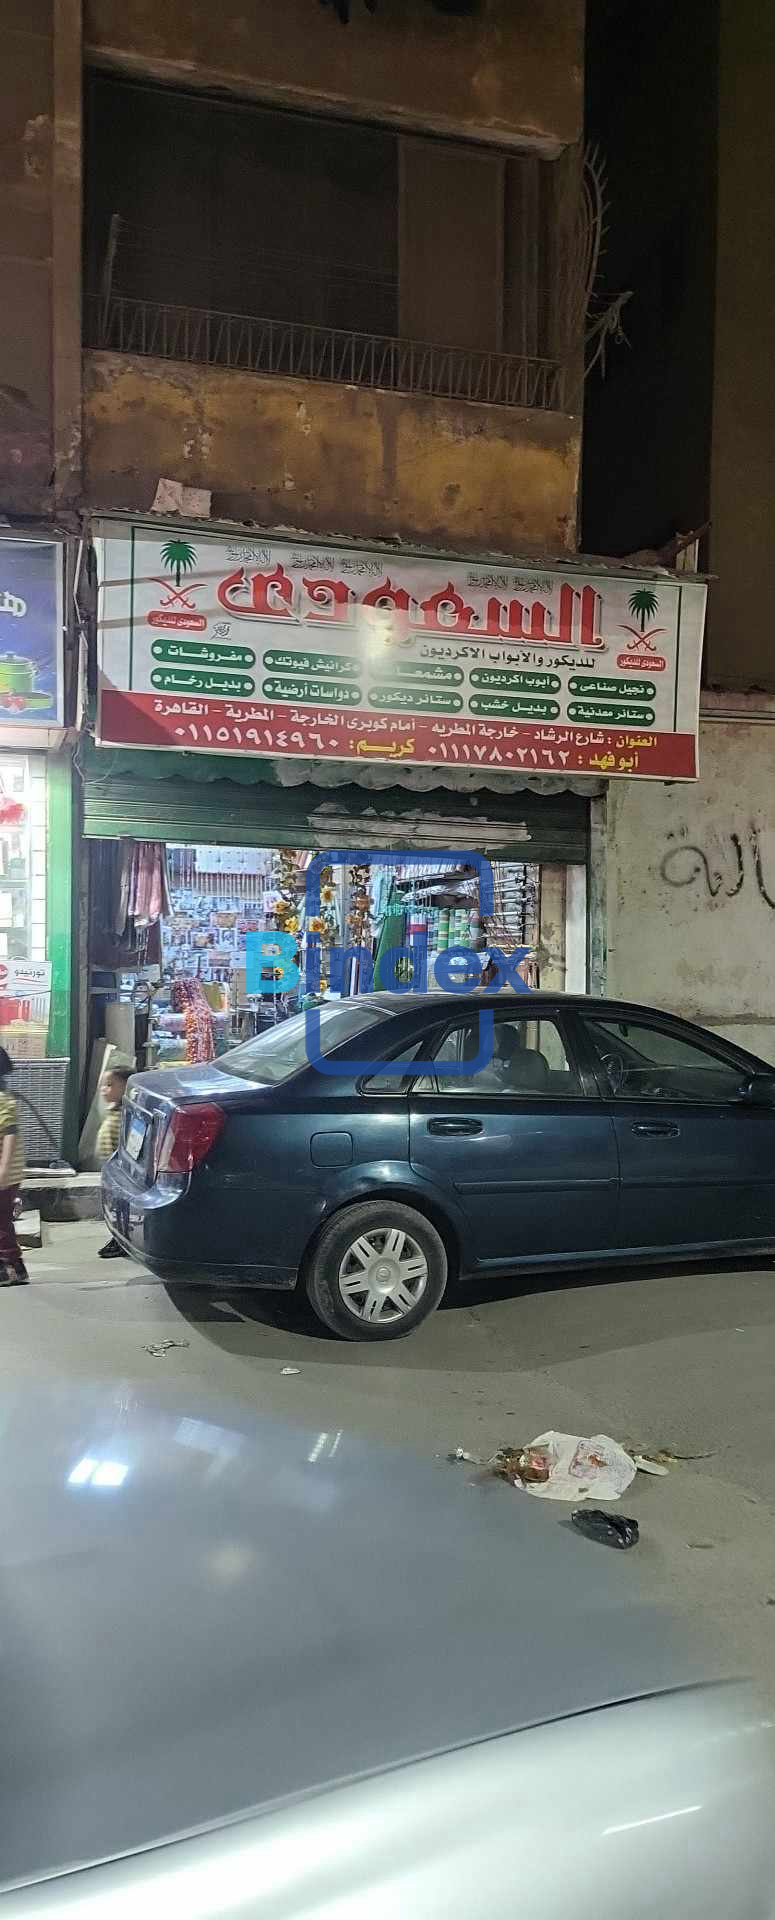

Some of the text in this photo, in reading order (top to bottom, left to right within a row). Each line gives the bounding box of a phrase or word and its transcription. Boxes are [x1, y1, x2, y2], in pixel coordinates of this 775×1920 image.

[167, 645, 243, 662] مفروشات
[546, 654, 595, 670] للديكور
[274, 656, 352, 673] كرانيش فيوتك
[164, 674, 242, 691] بديل رخام
[481, 672, 523, 685] اكرديون
[274, 680, 349, 702] دواسات أرضية
[579, 681, 645, 696] نجيل صناعى
[379, 691, 451, 706] ستائر ديكور
[481, 698, 547, 714] بديل خشب
[154, 699, 209, 716] القاهرة
[225, 703, 274, 722] المطرية
[577, 705, 645, 721] ستائر معدنية
[291, 709, 345, 727] الخارجة
[390, 718, 416, 732] أمام
[175, 723, 339, 750] ٠١١٥١٩١٤٩٦٠
[478, 723, 519, 740] خارجة
[534, 727, 573, 744] الرشاد
[575, 731, 605, 747] شارع
[615, 735, 657, 748] العنوان
[428, 742, 570, 767] ٠١١١٧٨٠٢١٦٢
[589, 751, 616, 770] فهد
[619, 752, 639, 773] أبو
